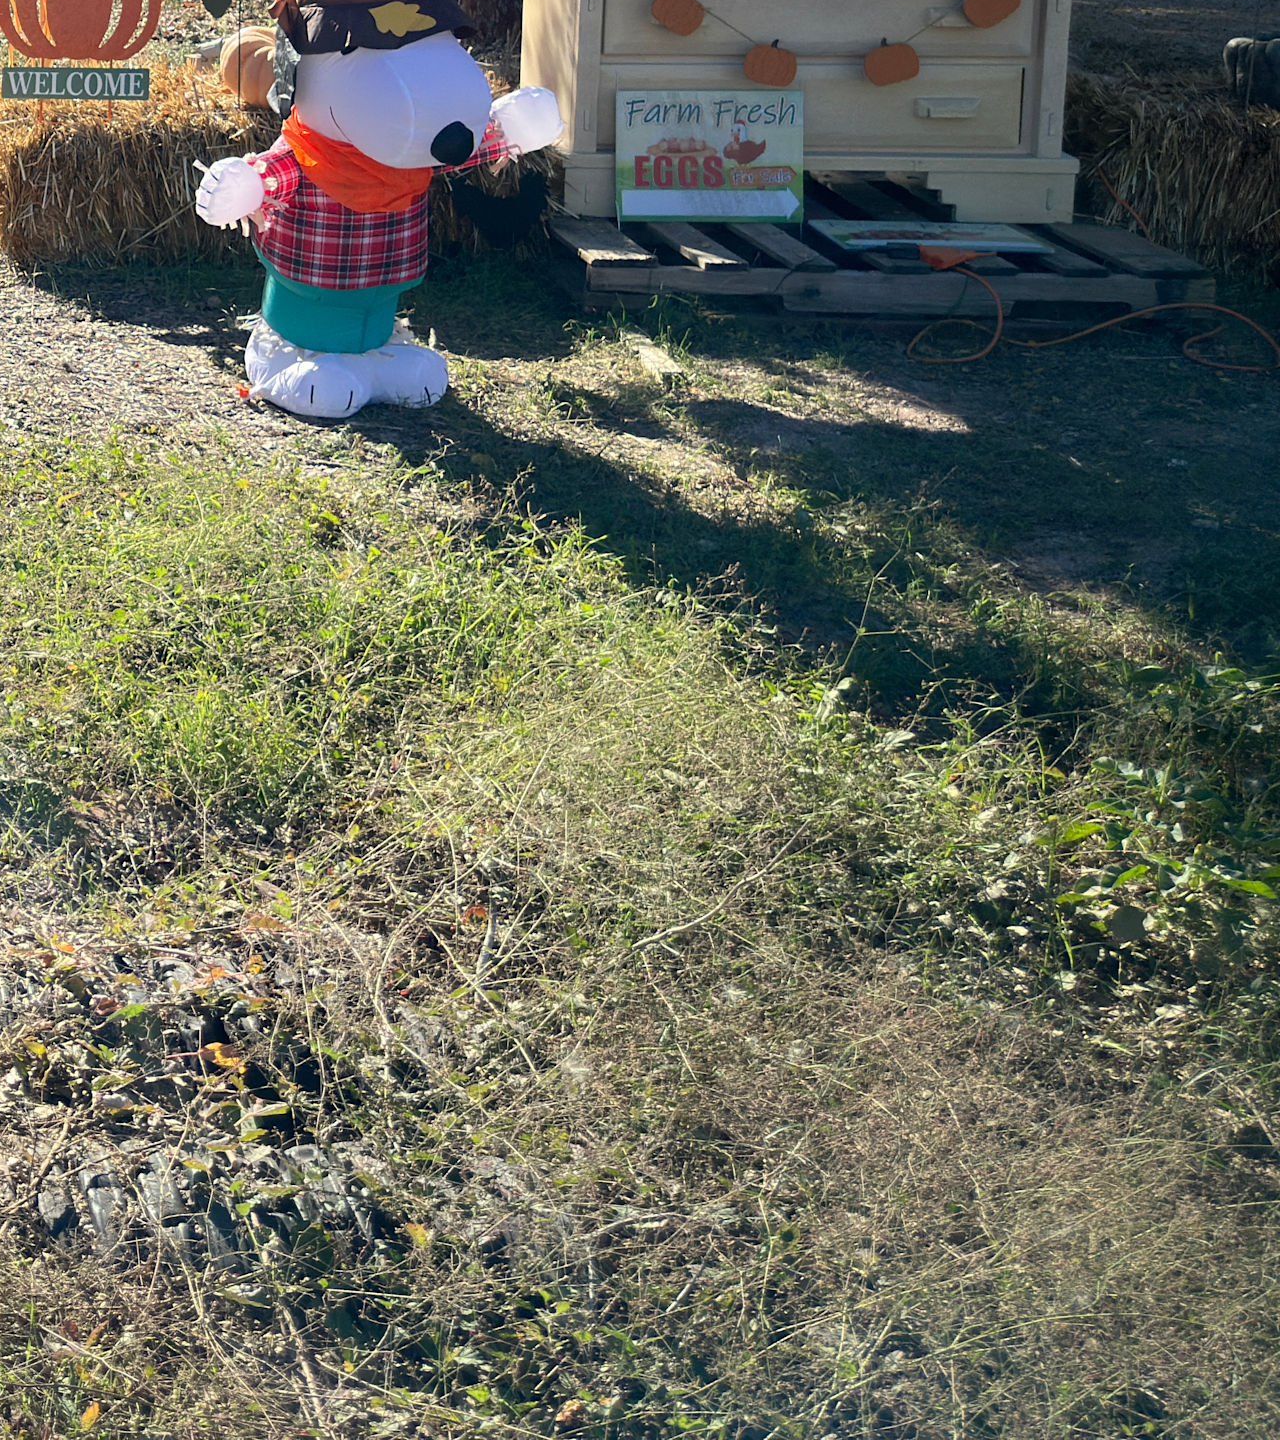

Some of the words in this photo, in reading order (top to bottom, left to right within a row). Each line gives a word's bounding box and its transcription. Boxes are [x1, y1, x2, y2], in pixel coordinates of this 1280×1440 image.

[7, 71, 145, 97] WELCOME
[626, 99, 701, 127] Farm
[713, 97, 797, 128] Fresh
[634, 155, 726, 189] EGGS
[760, 170, 792, 184] Sale
